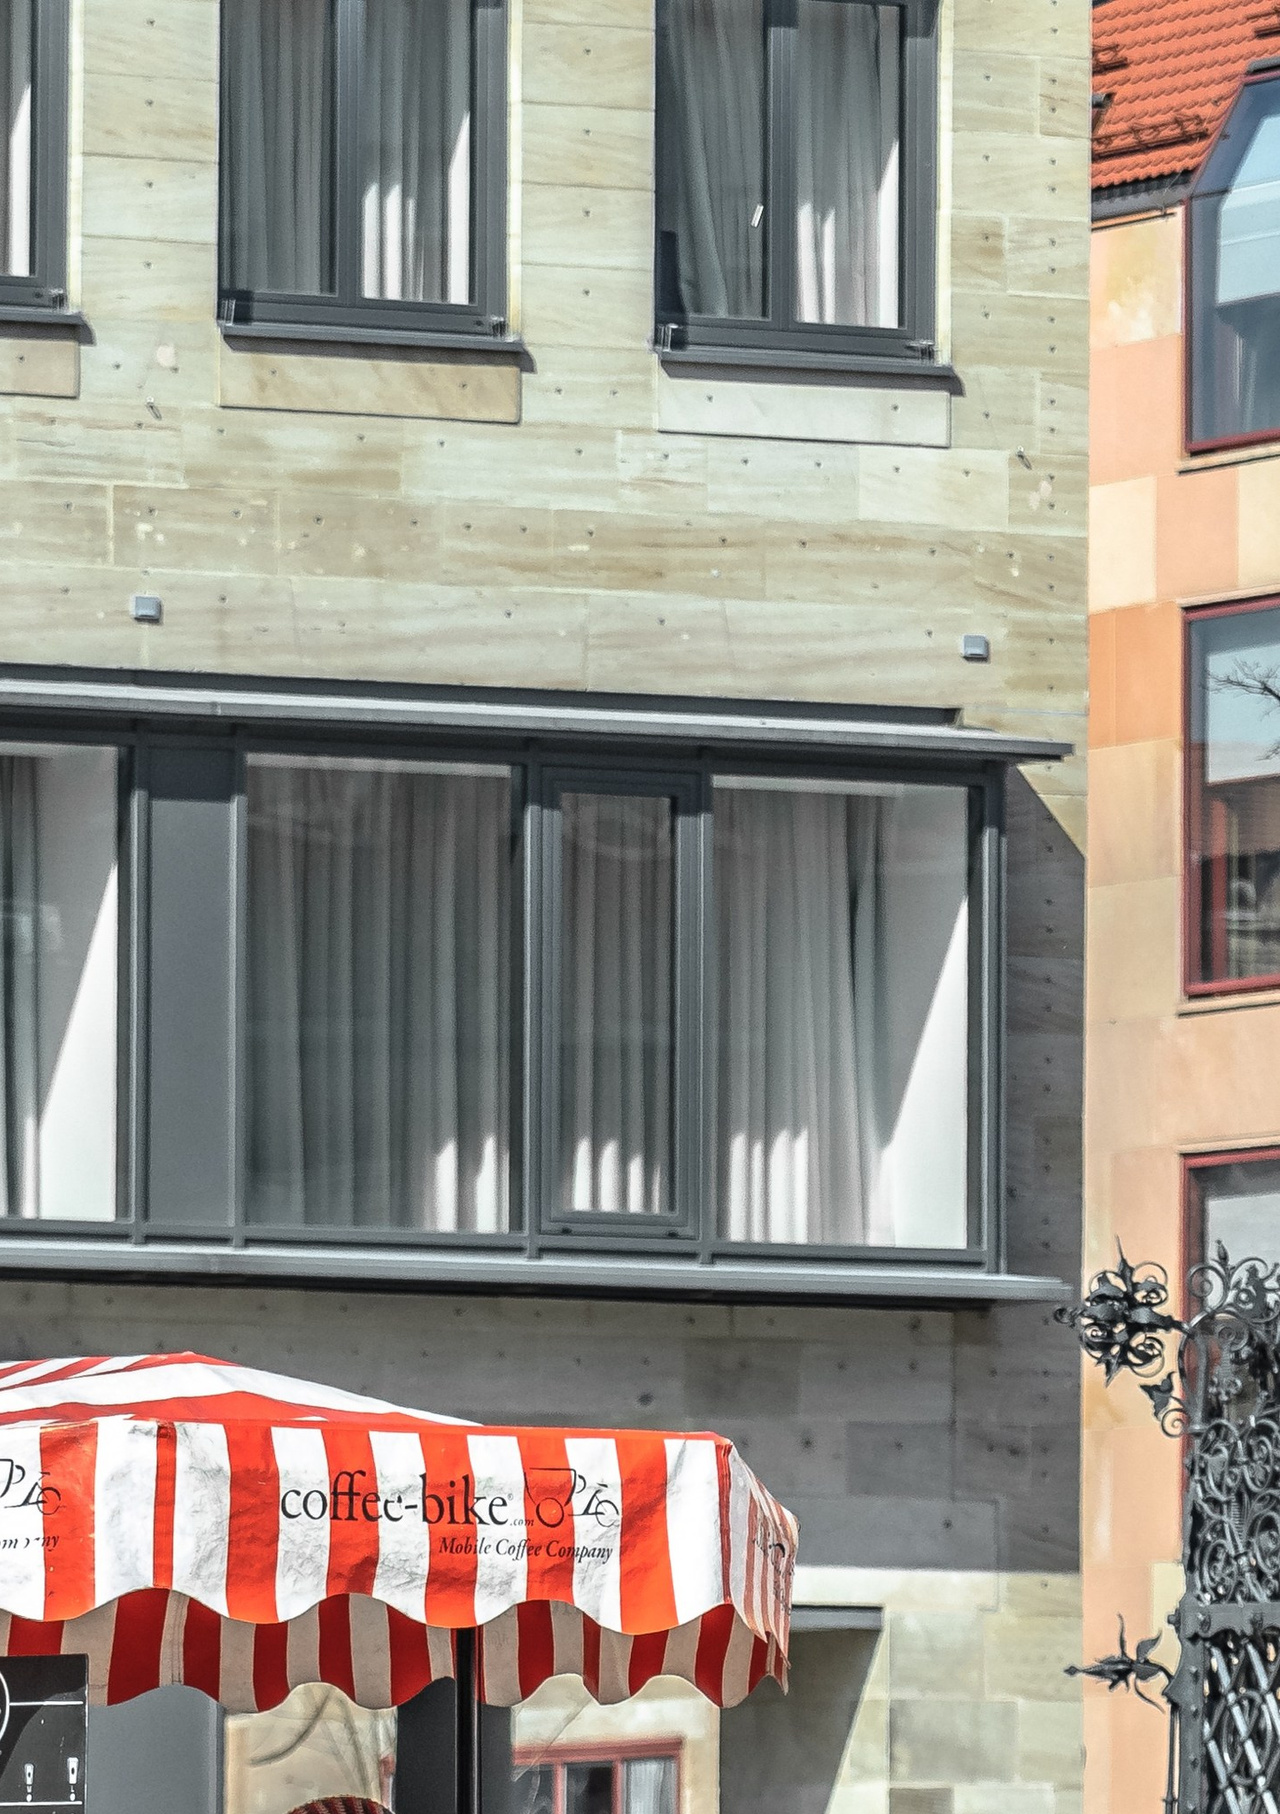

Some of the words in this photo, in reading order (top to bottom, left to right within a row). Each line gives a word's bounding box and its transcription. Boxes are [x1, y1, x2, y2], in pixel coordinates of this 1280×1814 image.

[439, 1536, 491, 1556] Mobile
[495, 1538, 543, 1561] Coffee
[545, 1539, 614, 1567] Company
